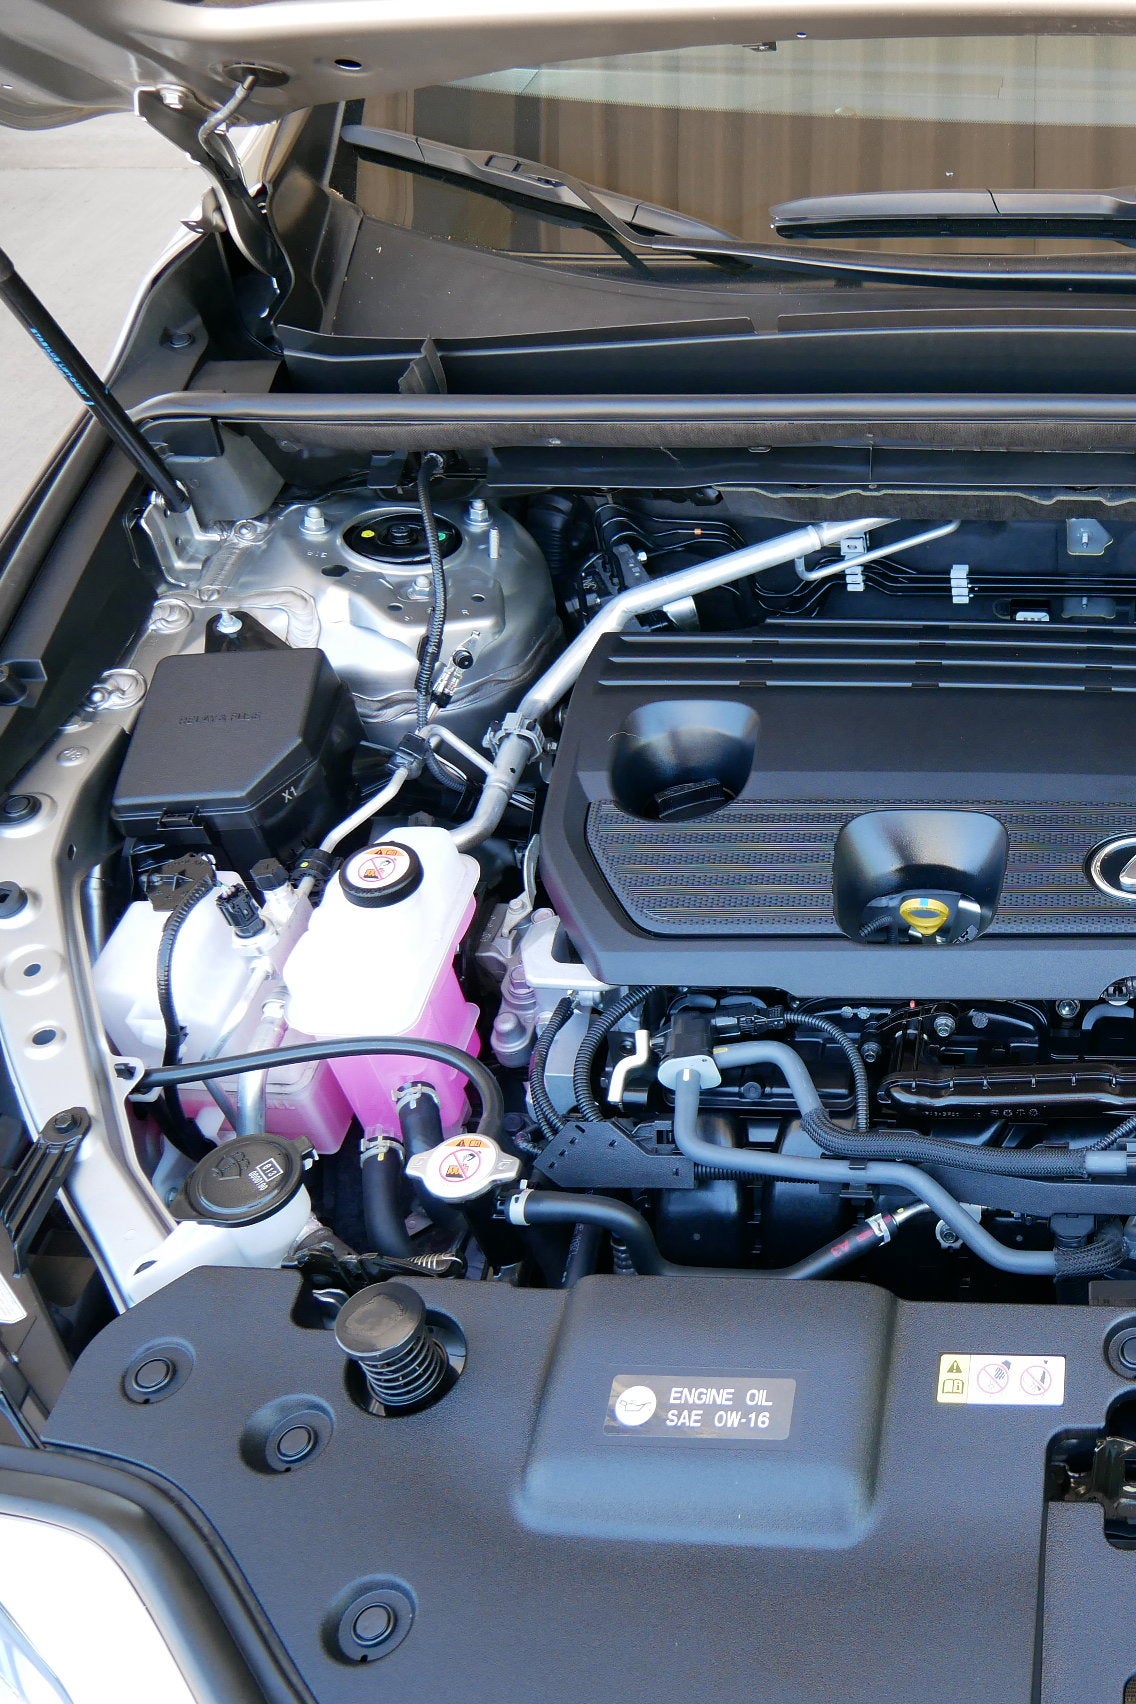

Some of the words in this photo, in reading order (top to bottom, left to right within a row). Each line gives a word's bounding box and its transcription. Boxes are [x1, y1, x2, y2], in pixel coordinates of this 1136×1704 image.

[281, 786, 298, 803] X1
[669, 1387, 735, 1405] ENGINE
[745, 1389, 773, 1406] OIL
[665, 1410, 703, 1427] SAE
[714, 1411, 770, 1428] 0W-16
